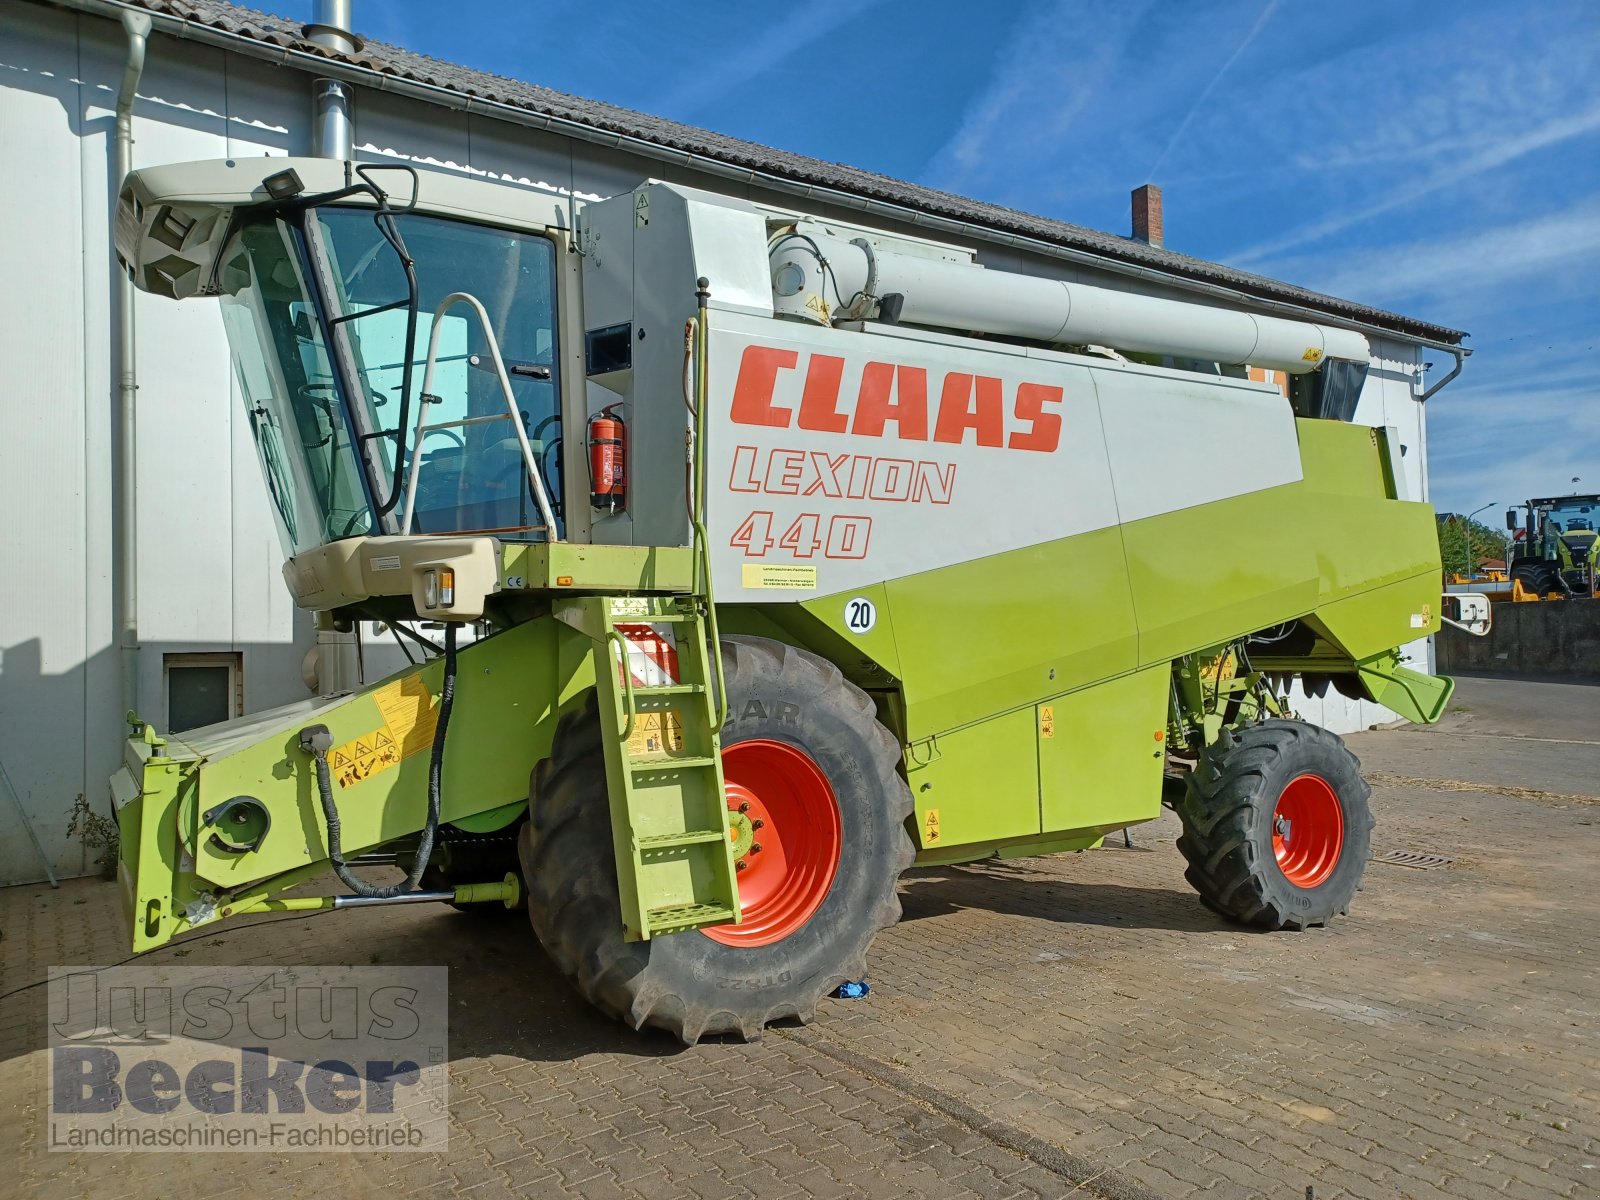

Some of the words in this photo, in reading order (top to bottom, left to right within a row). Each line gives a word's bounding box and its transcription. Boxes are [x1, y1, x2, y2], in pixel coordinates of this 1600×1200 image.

[730, 345, 1063, 452] CLAAS
[729, 445, 956, 504] LEXION
[730, 510, 872, 560] 440
[507, 576, 522, 587] CE
[850, 602, 871, 629] 20
